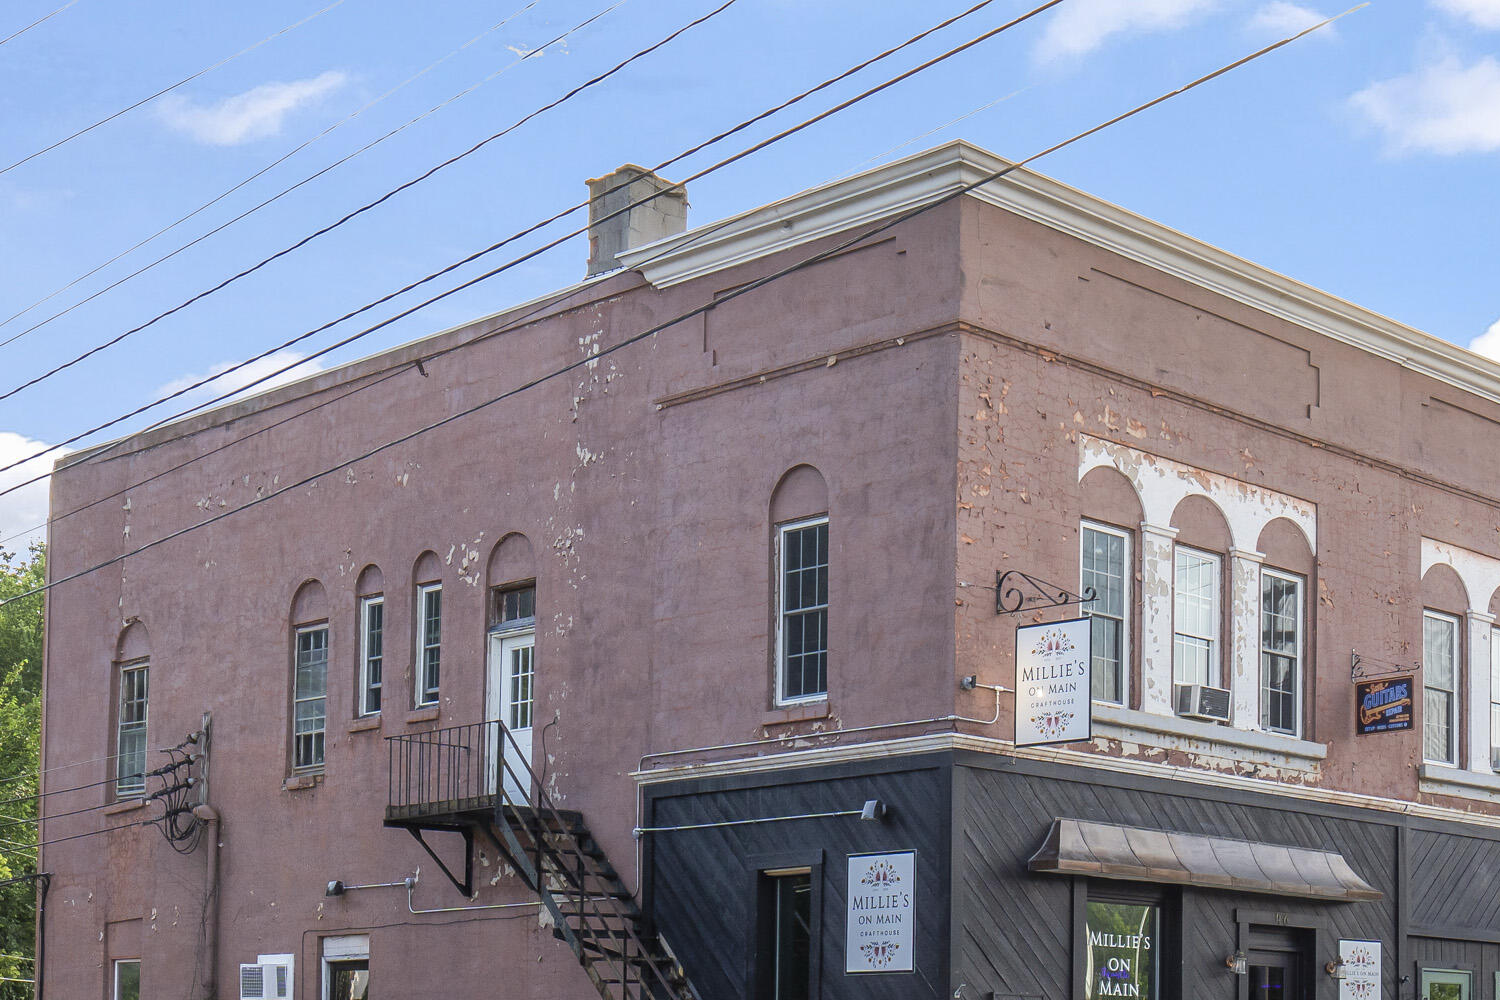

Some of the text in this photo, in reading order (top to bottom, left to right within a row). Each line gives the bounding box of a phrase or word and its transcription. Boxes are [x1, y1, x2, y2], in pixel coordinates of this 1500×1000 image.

[1022, 660, 1085, 682] MILLIE'S
[1049, 682, 1077, 695] MAIN
[1363, 683, 1408, 710] GUITARS
[1031, 698, 1074, 709] CRAFTHOUSE
[852, 891, 910, 910] MILLIE'S
[858, 913, 902, 925] ON MAIN
[1089, 931, 1151, 950] MILLIE'S
[1108, 957, 1131, 972] ON
[1099, 980, 1139, 997] MAIN
